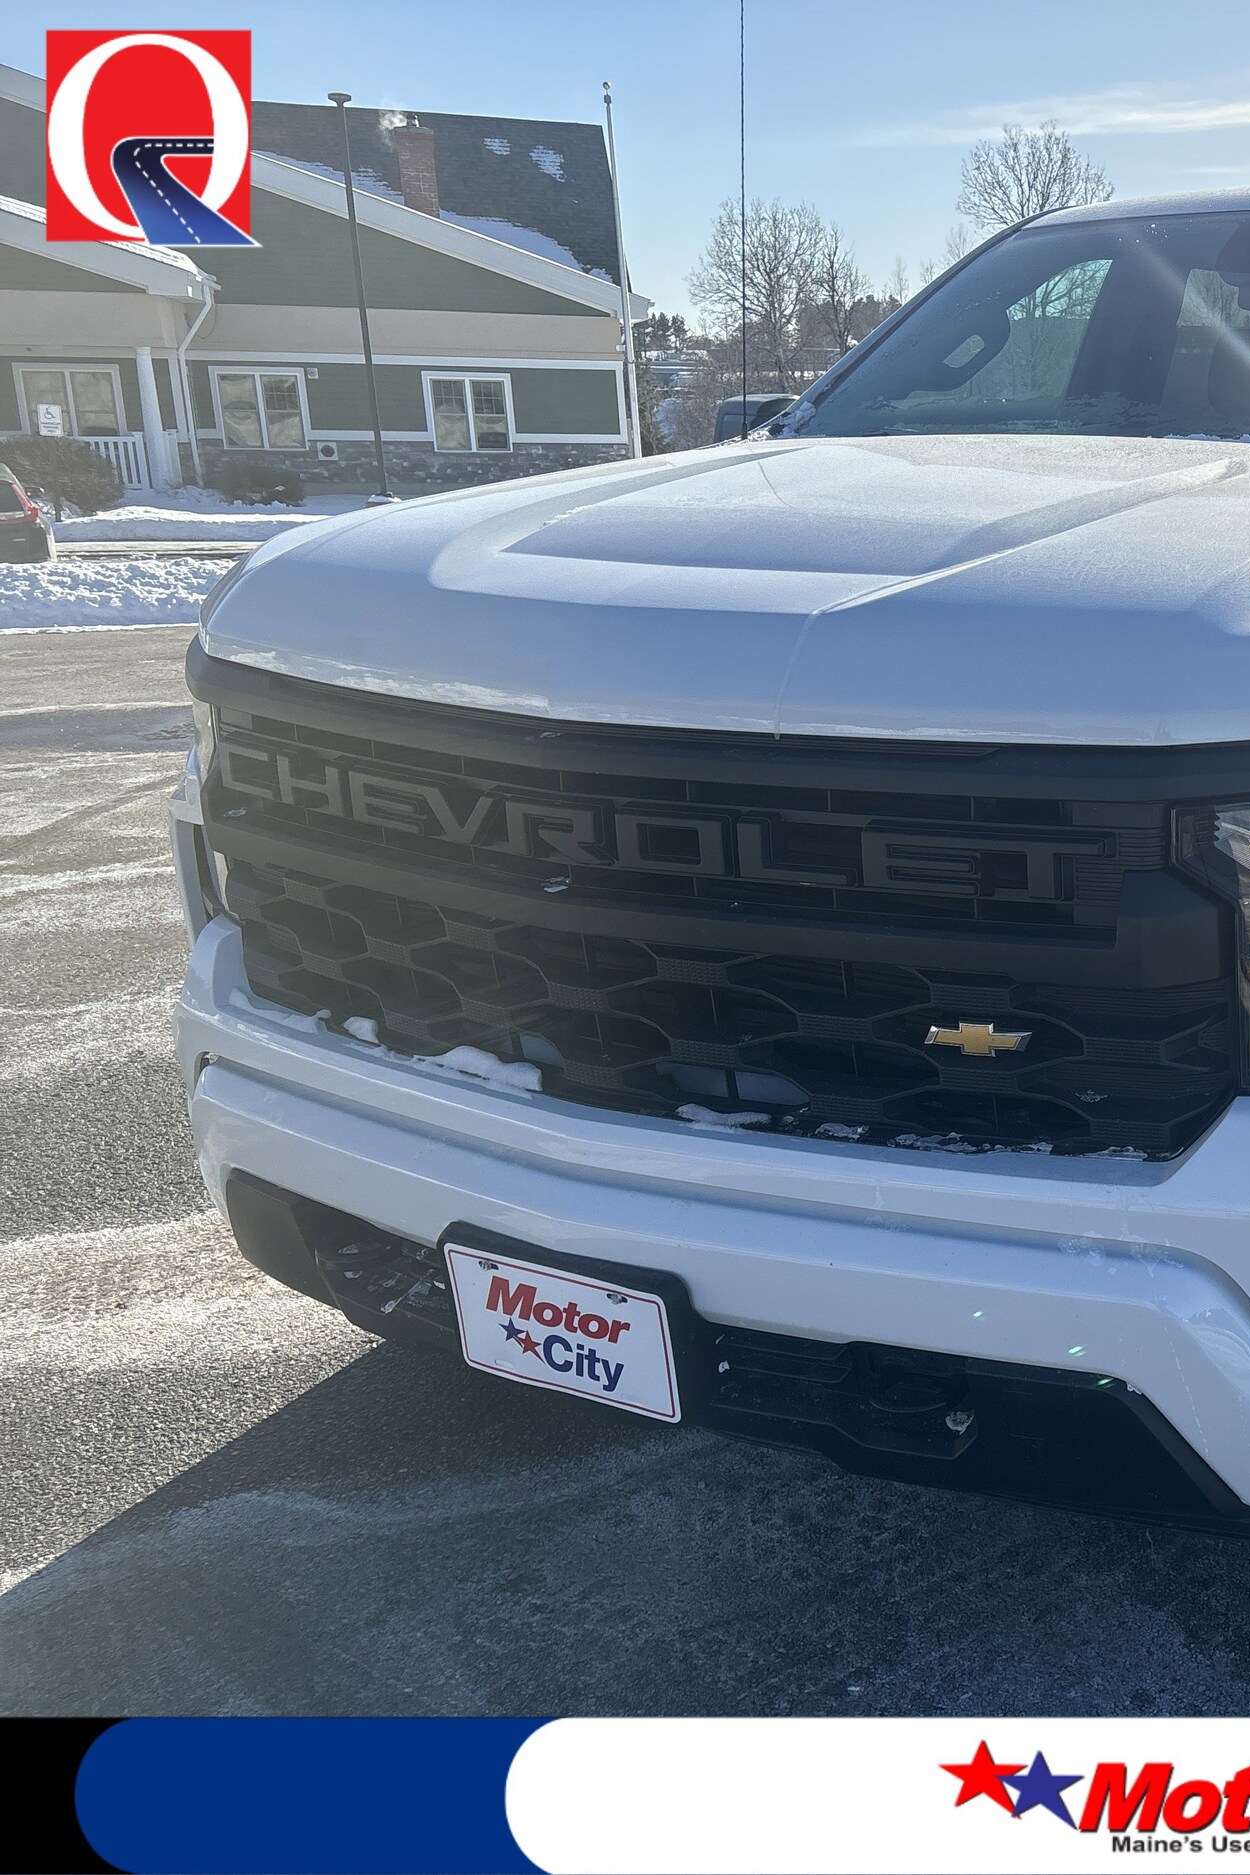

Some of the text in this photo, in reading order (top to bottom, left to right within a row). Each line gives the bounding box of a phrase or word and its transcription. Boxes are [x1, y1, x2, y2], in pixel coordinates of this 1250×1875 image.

[216, 740, 1107, 899] CHEVROLET
[486, 1275, 631, 1344] Motor
[542, 1334, 625, 1392] City
